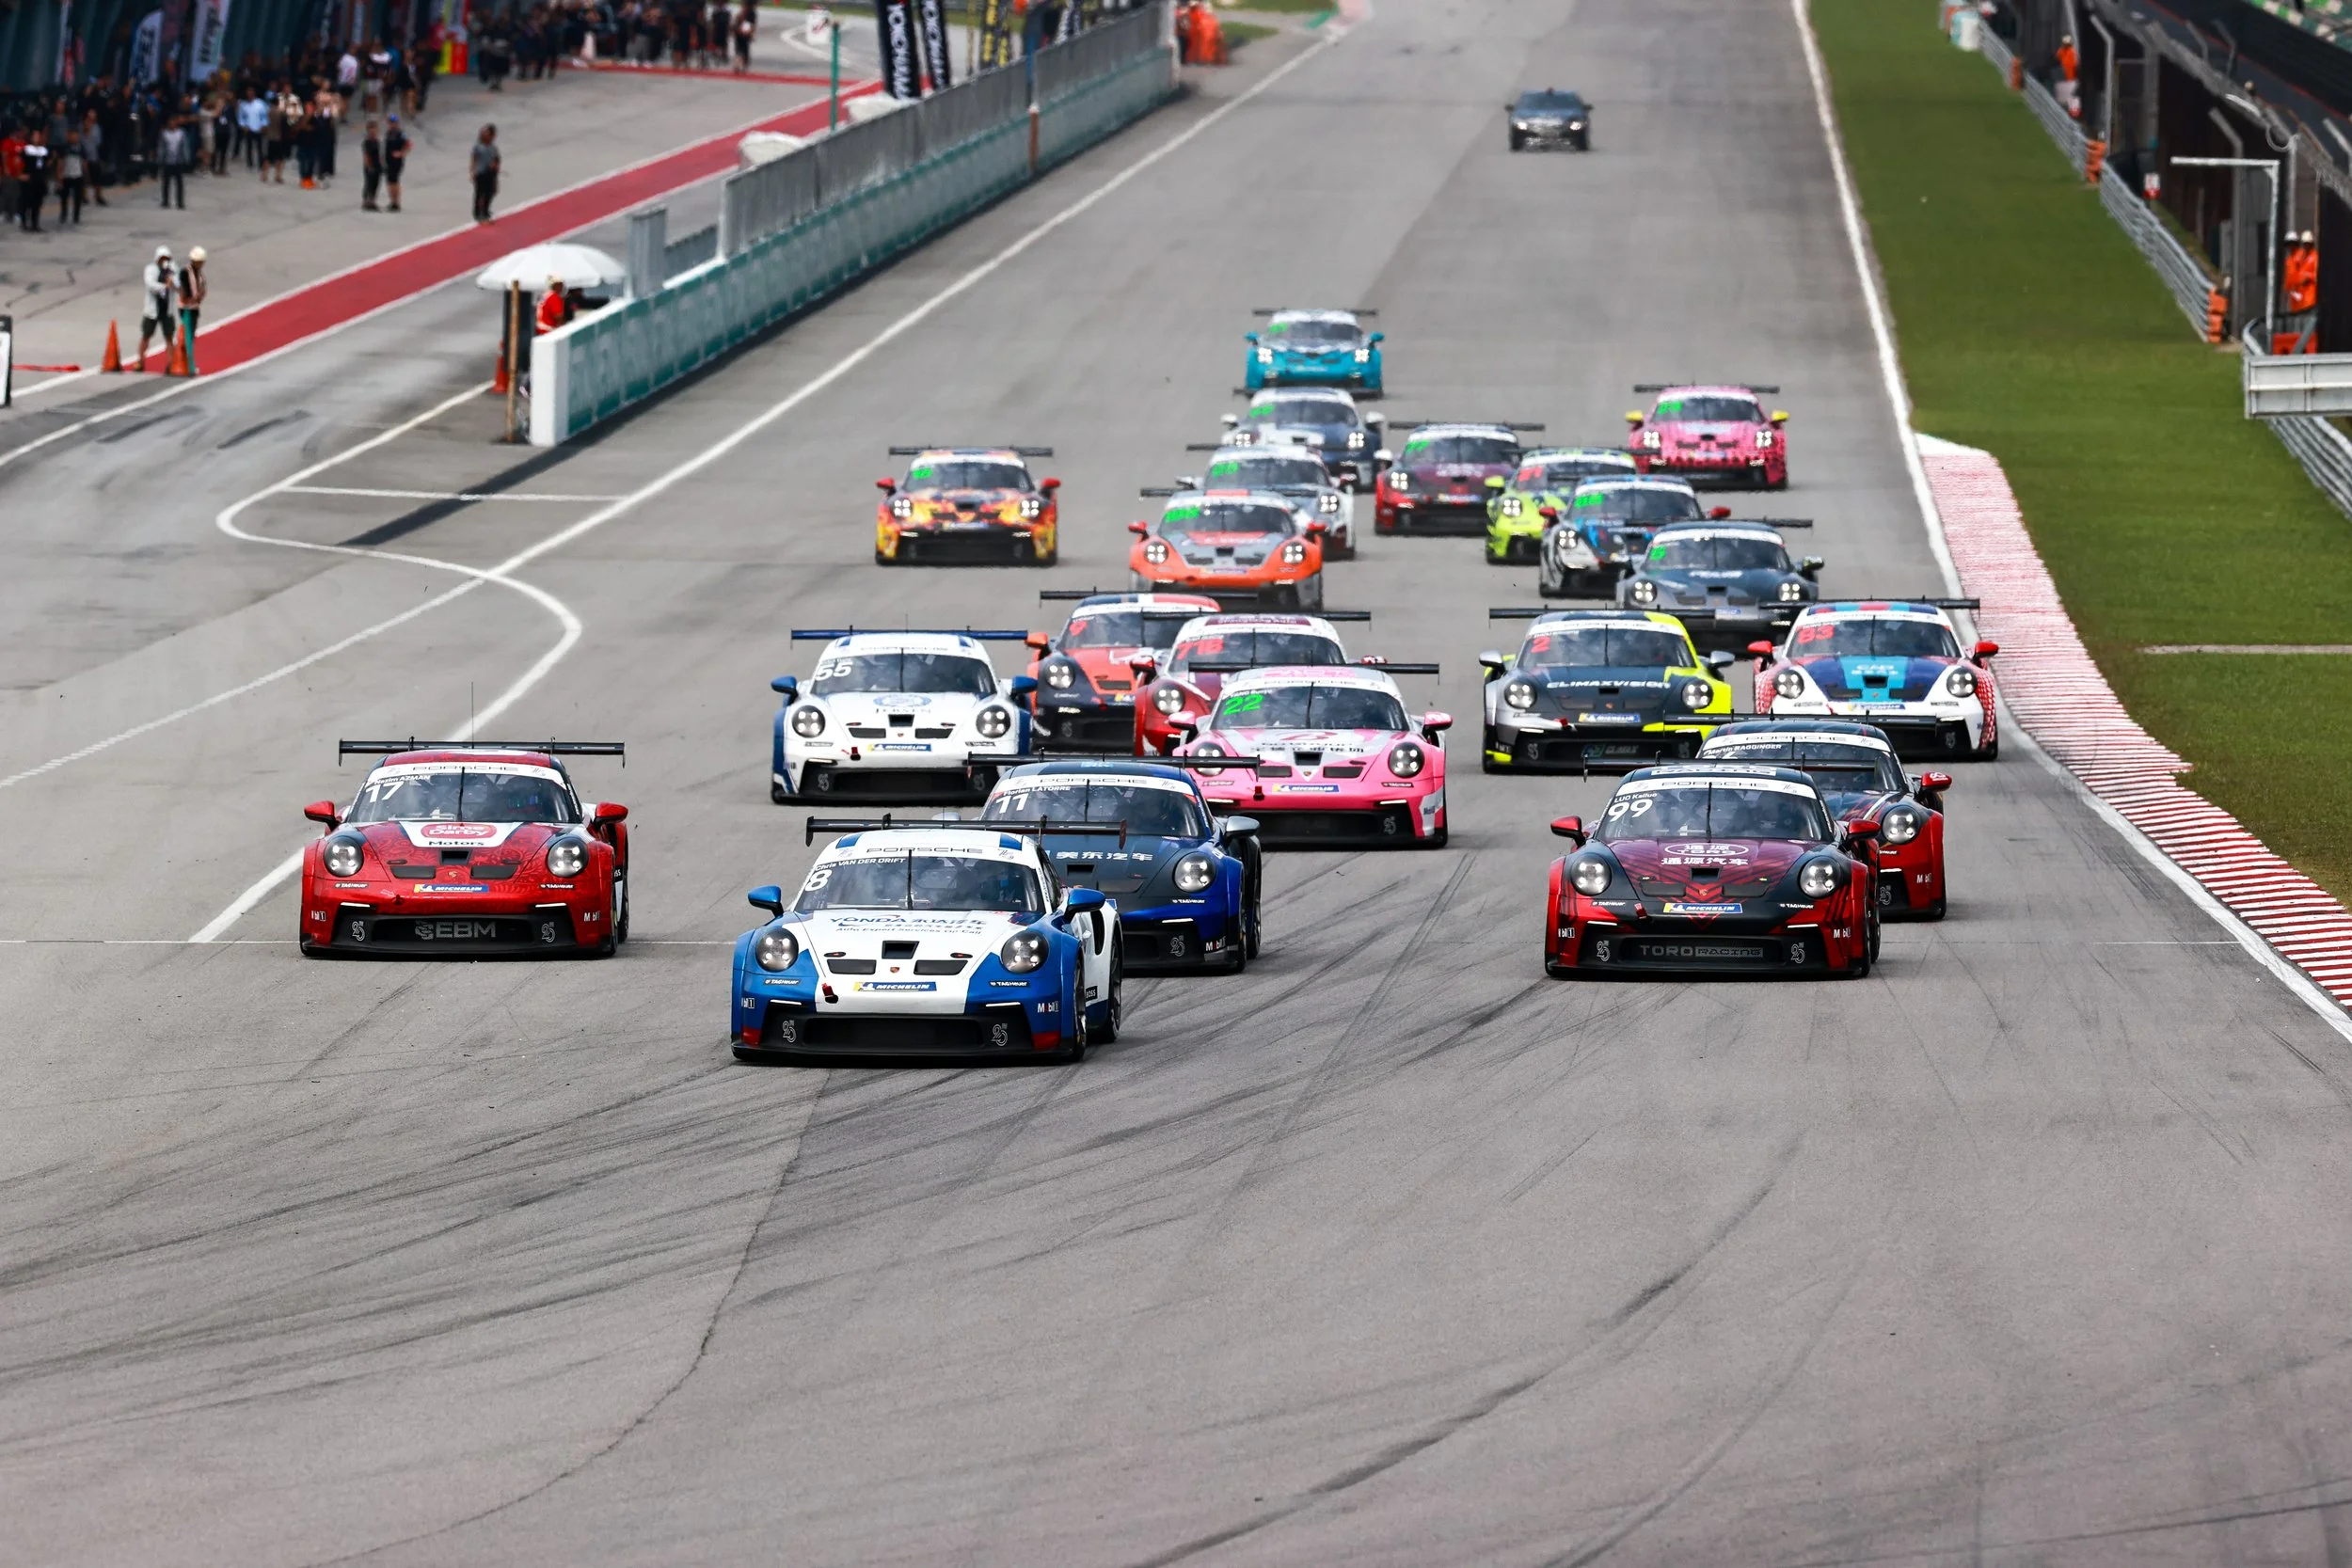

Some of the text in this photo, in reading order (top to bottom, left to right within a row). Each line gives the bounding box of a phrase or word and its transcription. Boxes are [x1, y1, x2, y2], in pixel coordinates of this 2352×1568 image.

[1797, 624, 1836, 644] 83
[1531, 636, 1550, 654] 2
[815, 660, 853, 681] 55
[1223, 693, 1264, 716] 22
[373, 776, 399, 784] Nazim
[366, 782, 405, 803] 17
[1003, 787, 1030, 797] Florian
[1614, 794, 1630, 802] LUO
[995, 792, 1029, 815] 11
[1608, 799, 1653, 822] 99
[815, 863, 836, 871] Chris
[804, 870, 833, 892] 8
[436, 921, 497, 938] EBM
[1640, 944, 1693, 957] TORO
